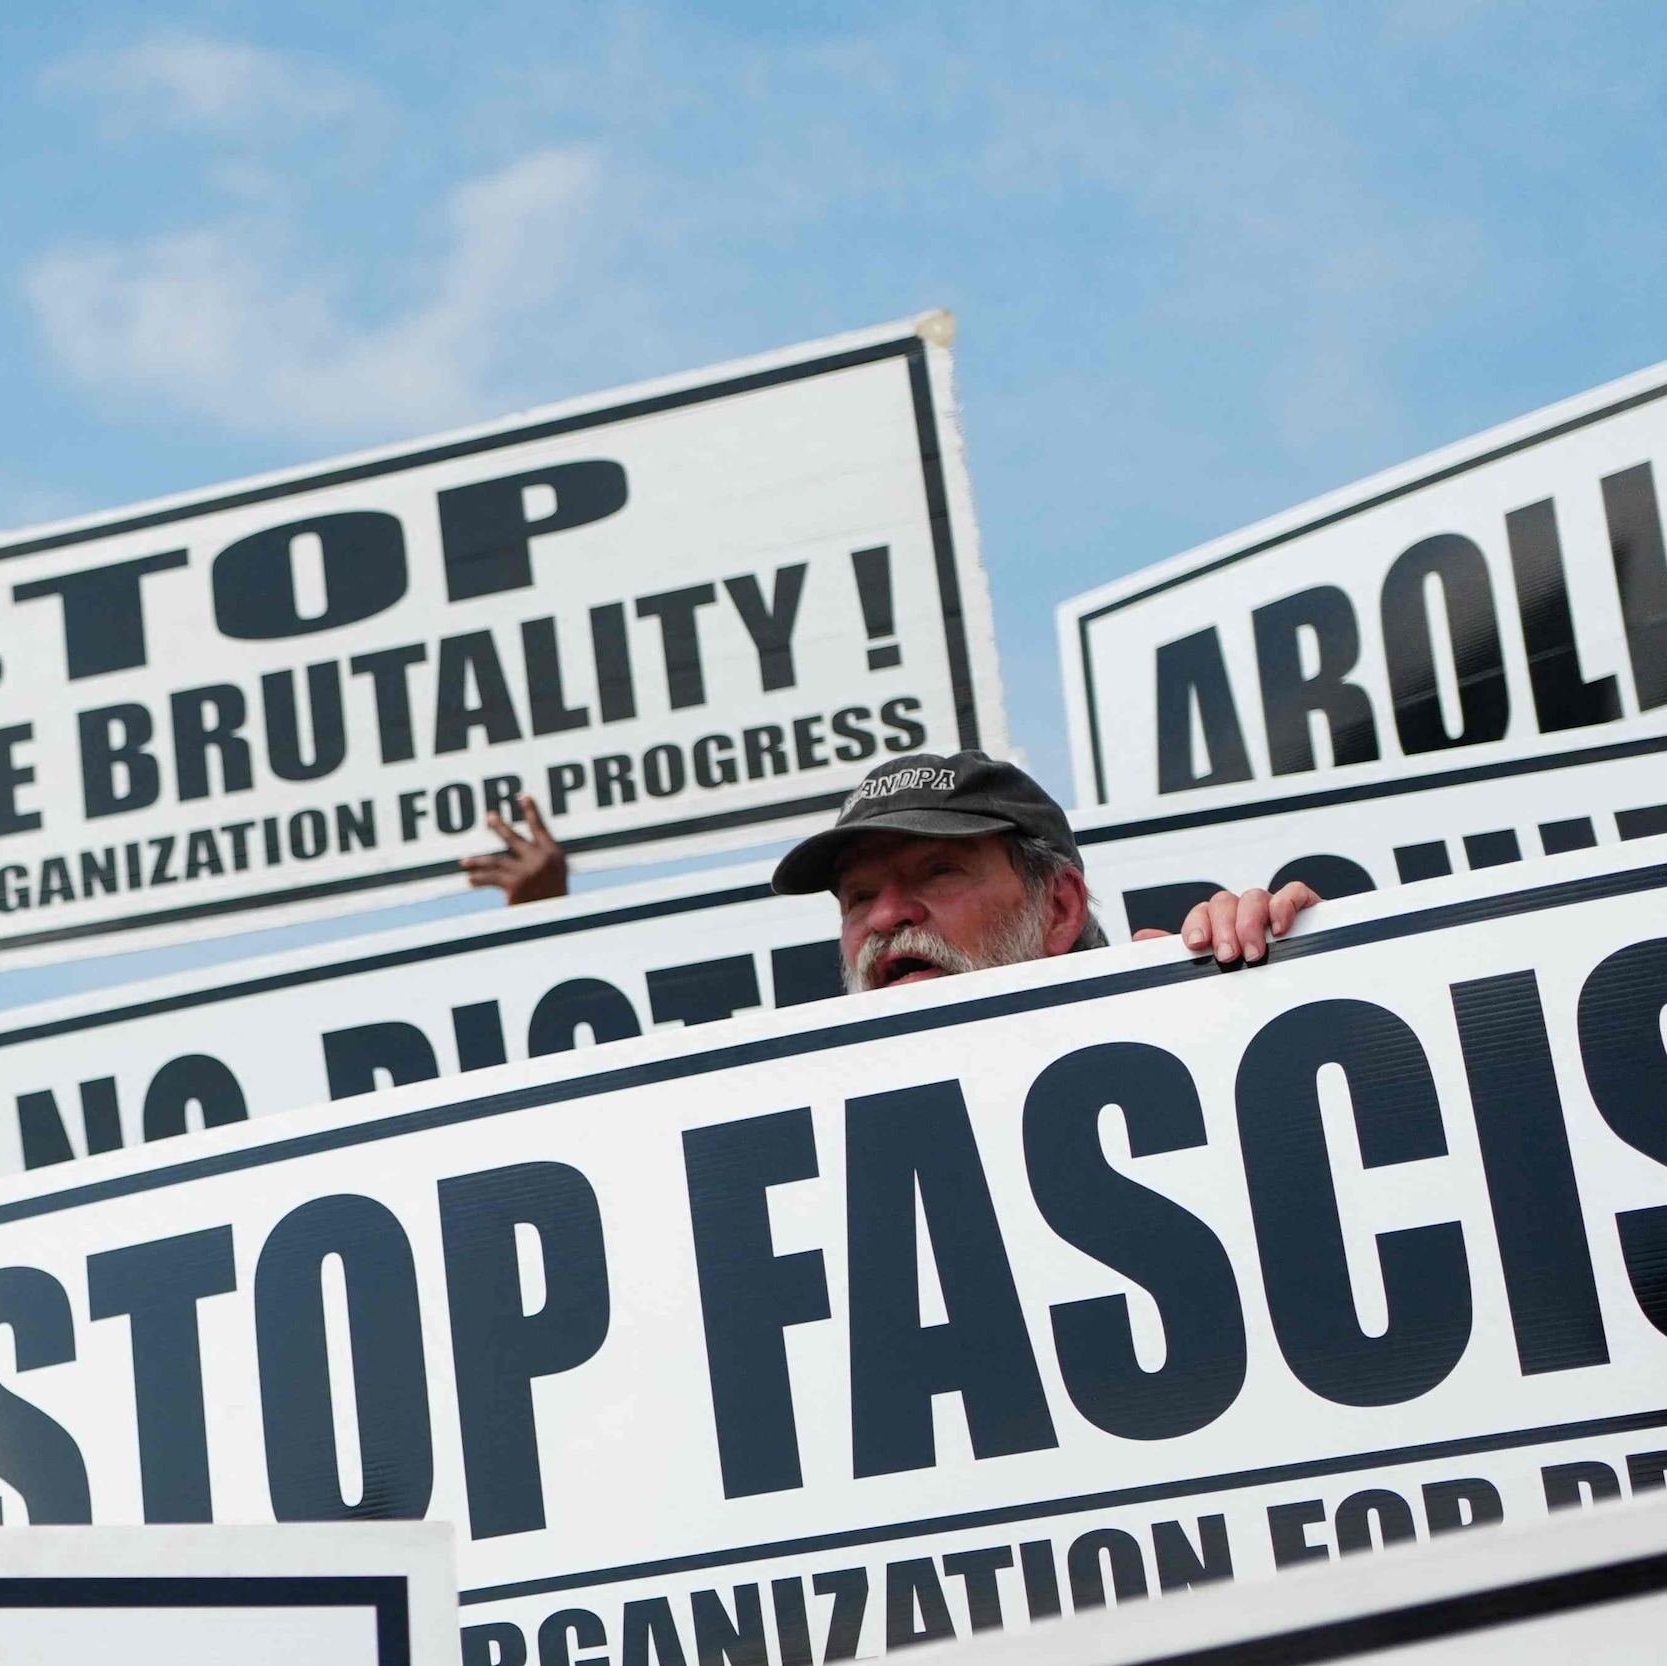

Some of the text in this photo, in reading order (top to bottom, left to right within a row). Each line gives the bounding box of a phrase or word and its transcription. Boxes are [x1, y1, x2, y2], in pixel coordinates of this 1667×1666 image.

[79, 563, 810, 821] BRUTALITY
[399, 770, 525, 845] FOR
[547, 696, 931, 818] PROGRESS
